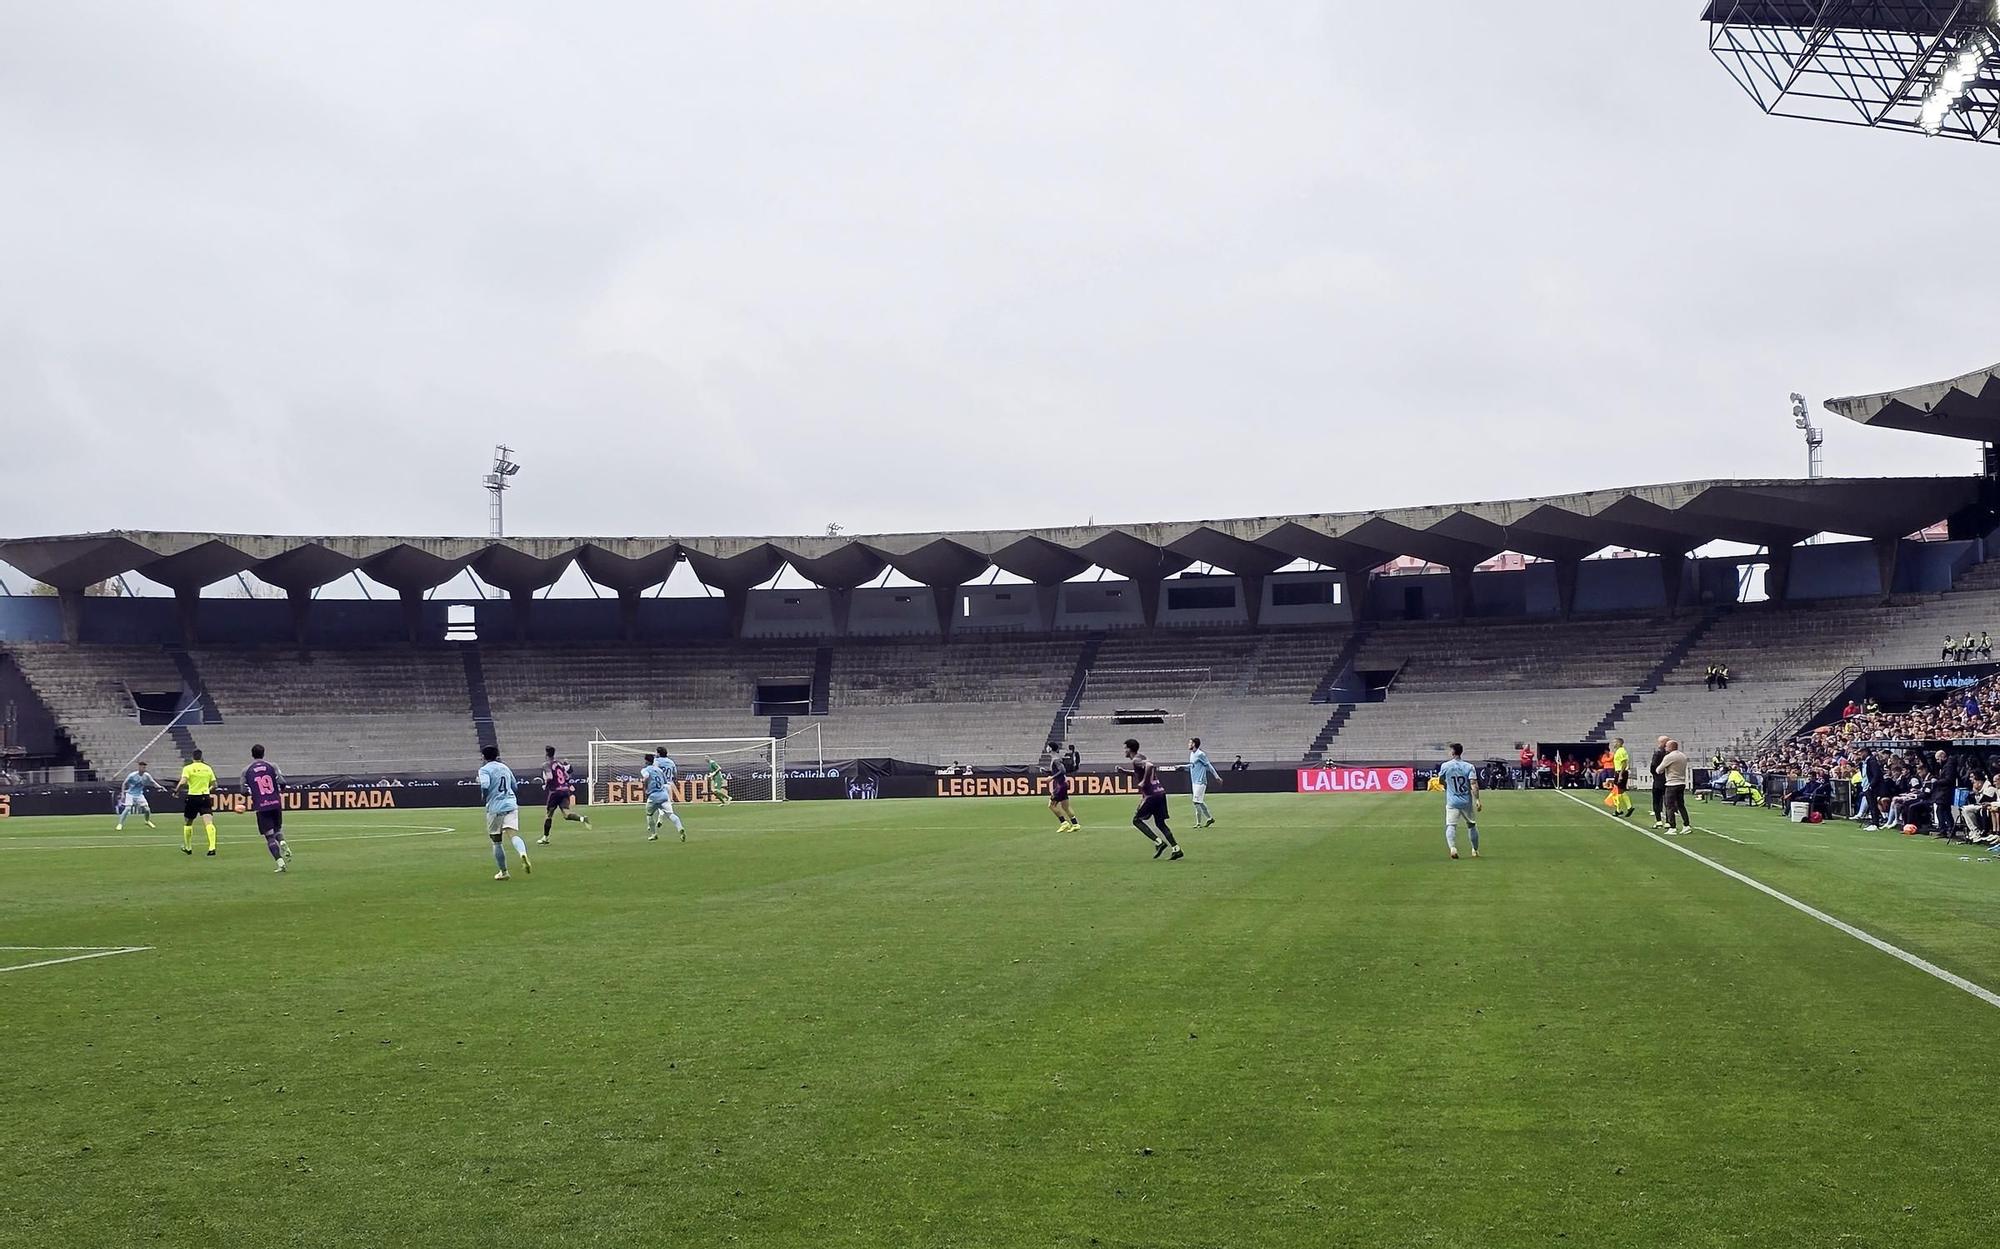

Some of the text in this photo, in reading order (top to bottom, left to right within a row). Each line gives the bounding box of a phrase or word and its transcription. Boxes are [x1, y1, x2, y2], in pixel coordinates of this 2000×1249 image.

[1903, 680, 1931, 689] VIAJES
[254, 774, 274, 795] 19
[498, 776, 508, 794] 4
[938, 776, 1139, 797] LEGENDS.FOTBALL
[1302, 770, 1381, 791] LALIGA
[280, 792, 301, 809] TU
[308, 790, 396, 809] ENTRADA
